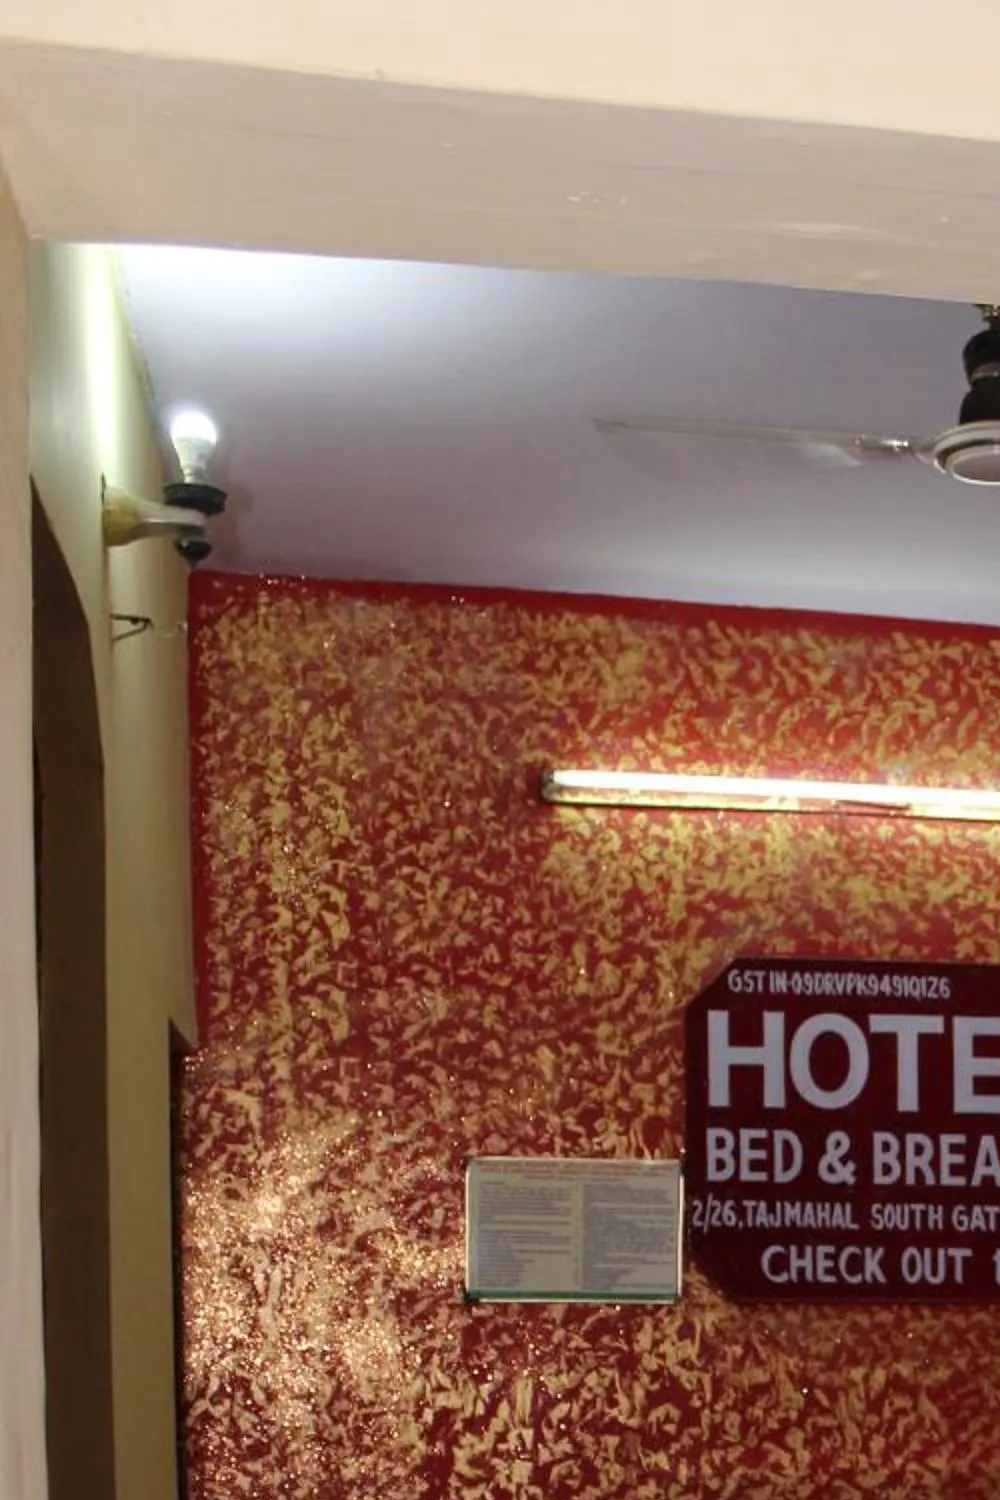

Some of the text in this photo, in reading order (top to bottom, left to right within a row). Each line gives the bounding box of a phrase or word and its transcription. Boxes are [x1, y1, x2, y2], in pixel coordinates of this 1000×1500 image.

[728, 969, 766, 993] GST
[706, 1128, 803, 1183] BED
[817, 1130, 857, 1184] &
[871, 1203, 943, 1231] SOUTH
[760, 1245, 887, 1284] CHECK
[900, 1247, 973, 1285] OUT
